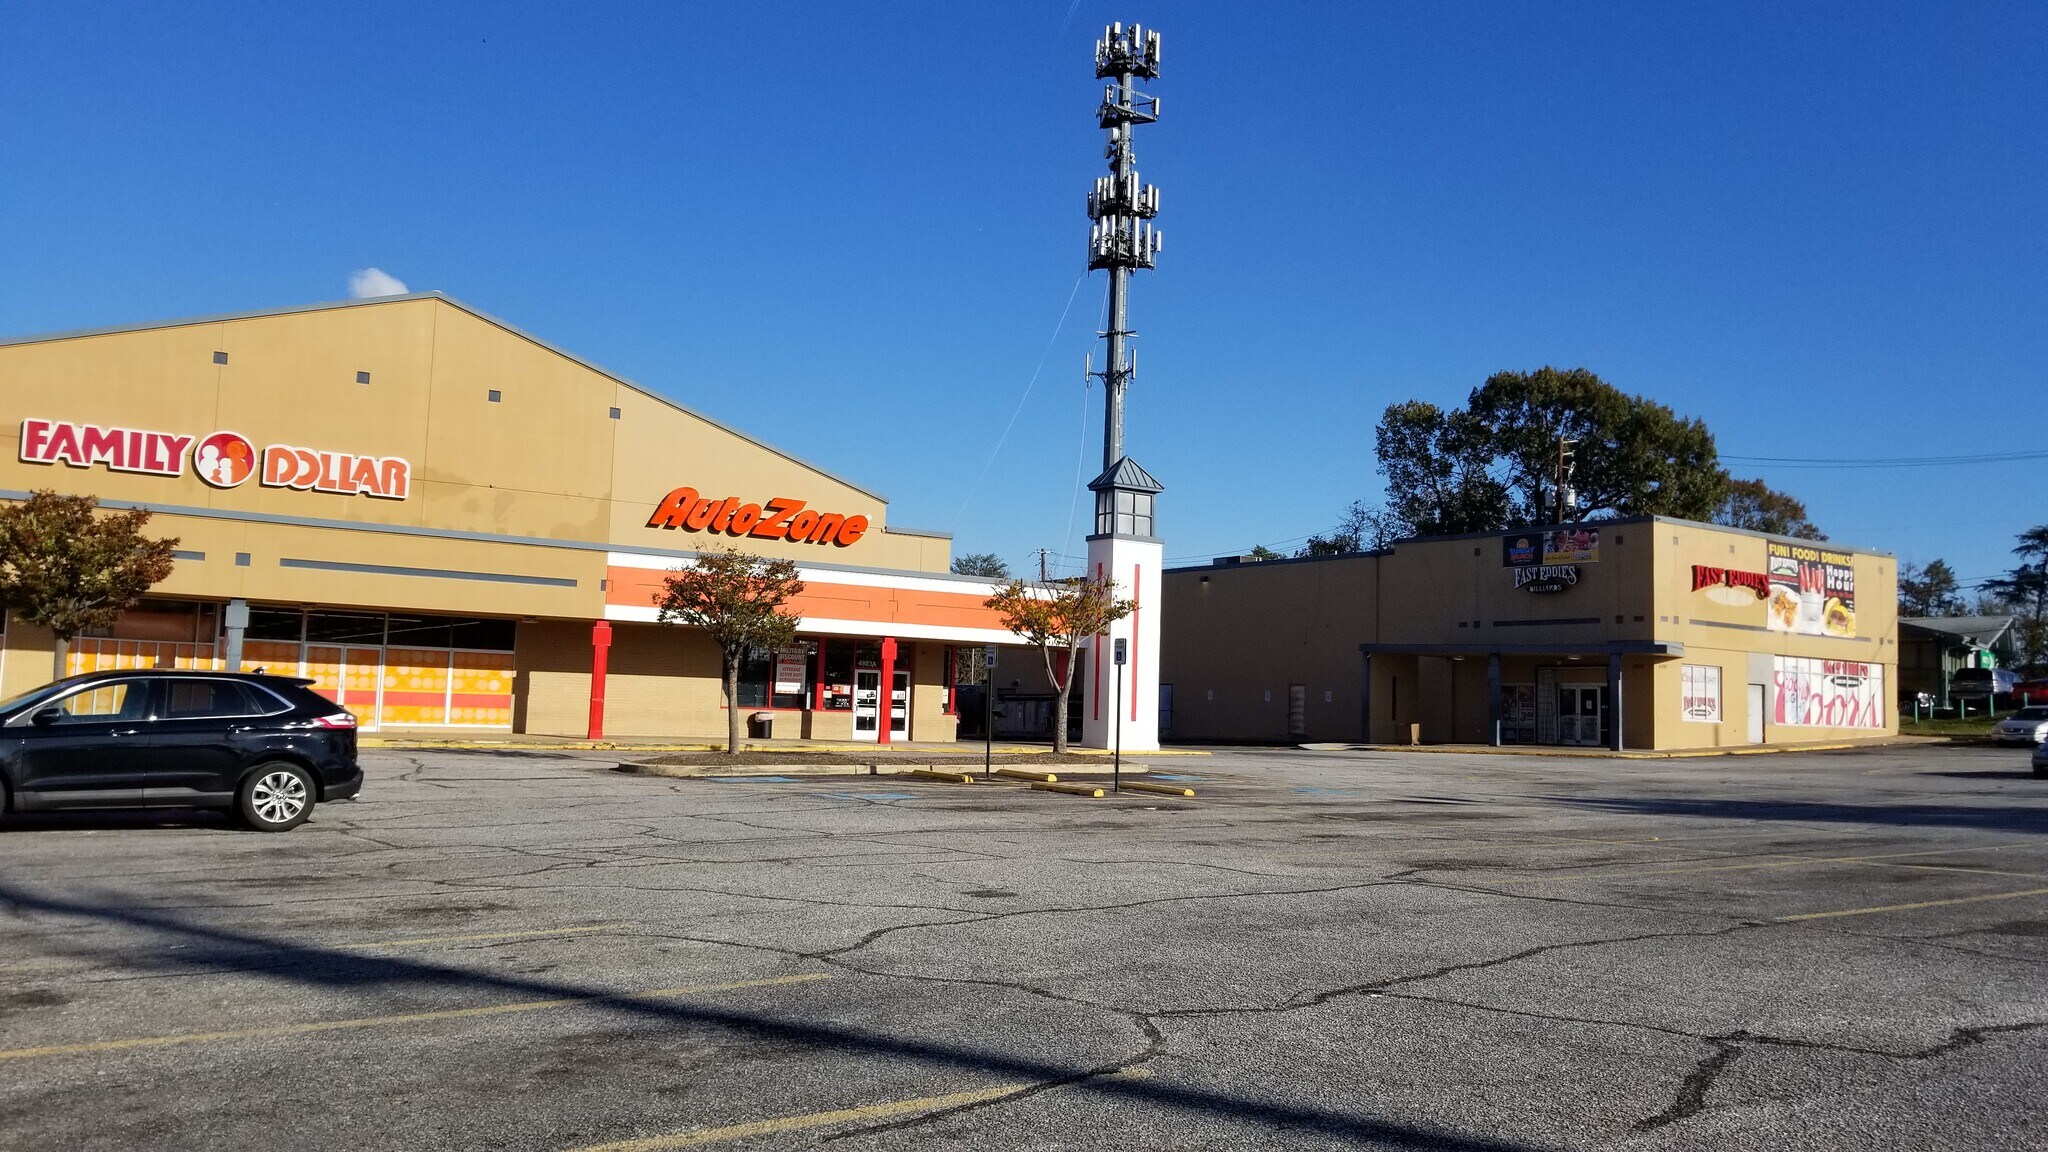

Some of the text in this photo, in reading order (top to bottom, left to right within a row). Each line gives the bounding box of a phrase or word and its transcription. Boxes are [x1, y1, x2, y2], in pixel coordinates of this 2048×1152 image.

[23, 419, 408, 498] FAMILY DOLLAR
[647, 487, 869, 547] AutoZone
[1769, 543, 1790, 557] FUN!
[1792, 547, 1819, 562] FOOD!
[1514, 567, 1538, 589] FAST
[1692, 565, 1724, 592] FAST
